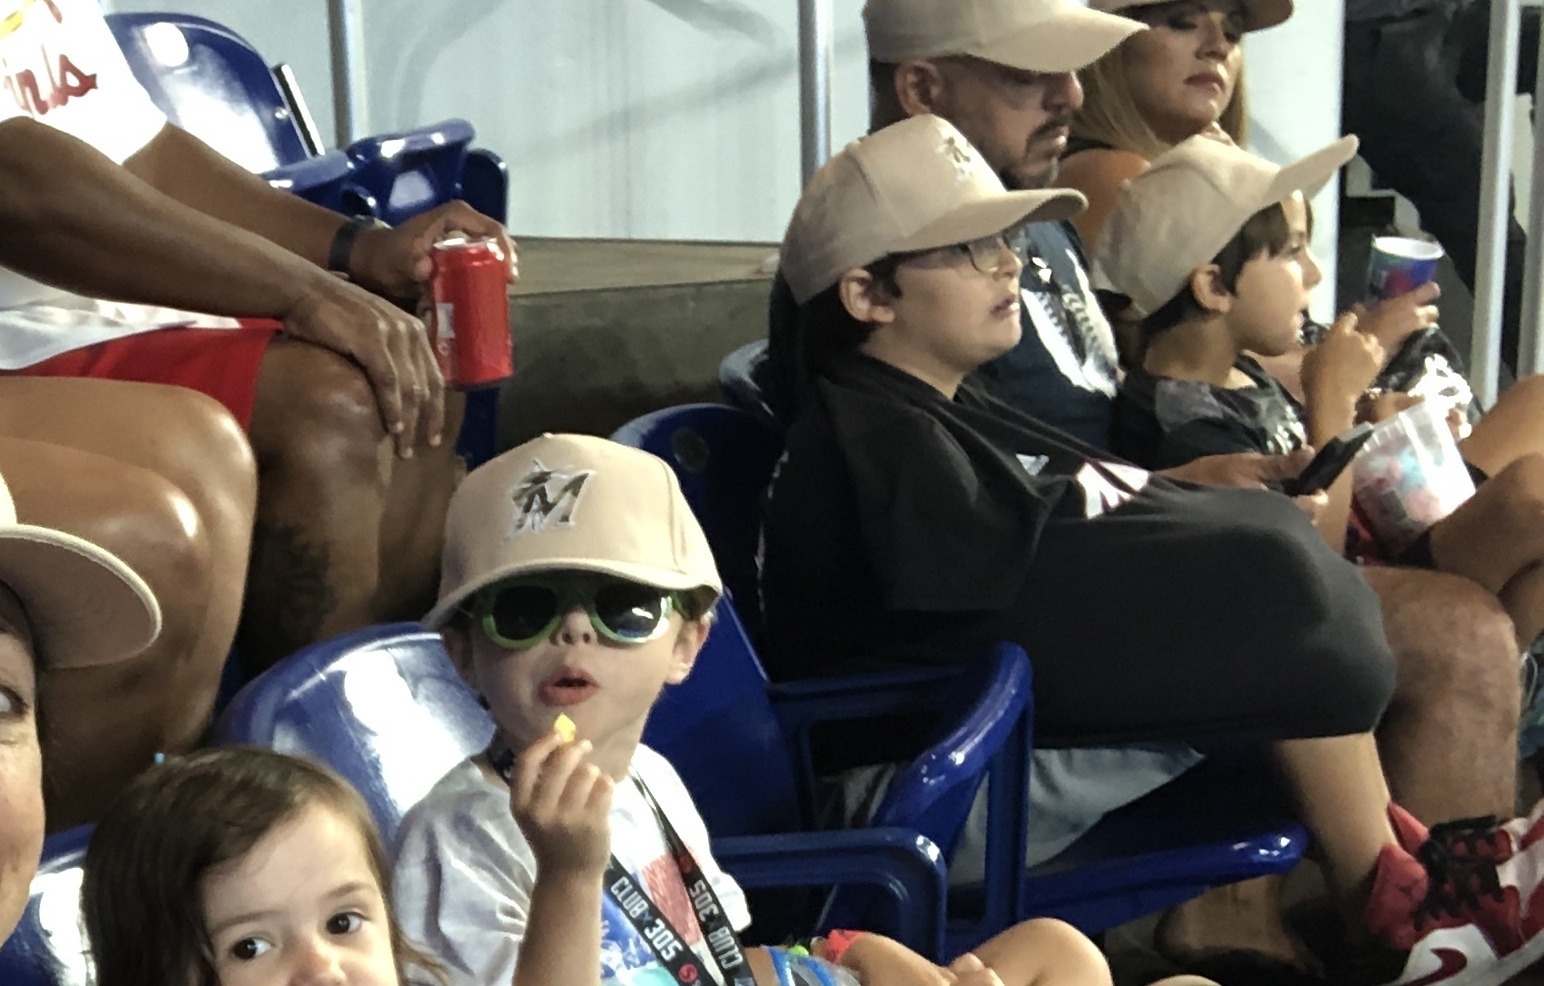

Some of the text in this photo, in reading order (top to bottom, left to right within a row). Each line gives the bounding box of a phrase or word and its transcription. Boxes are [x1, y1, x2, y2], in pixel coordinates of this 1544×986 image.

[611, 876, 649, 919] CLUB
[644, 917, 684, 962] 305
[690, 880, 743, 969] CLUB 305
